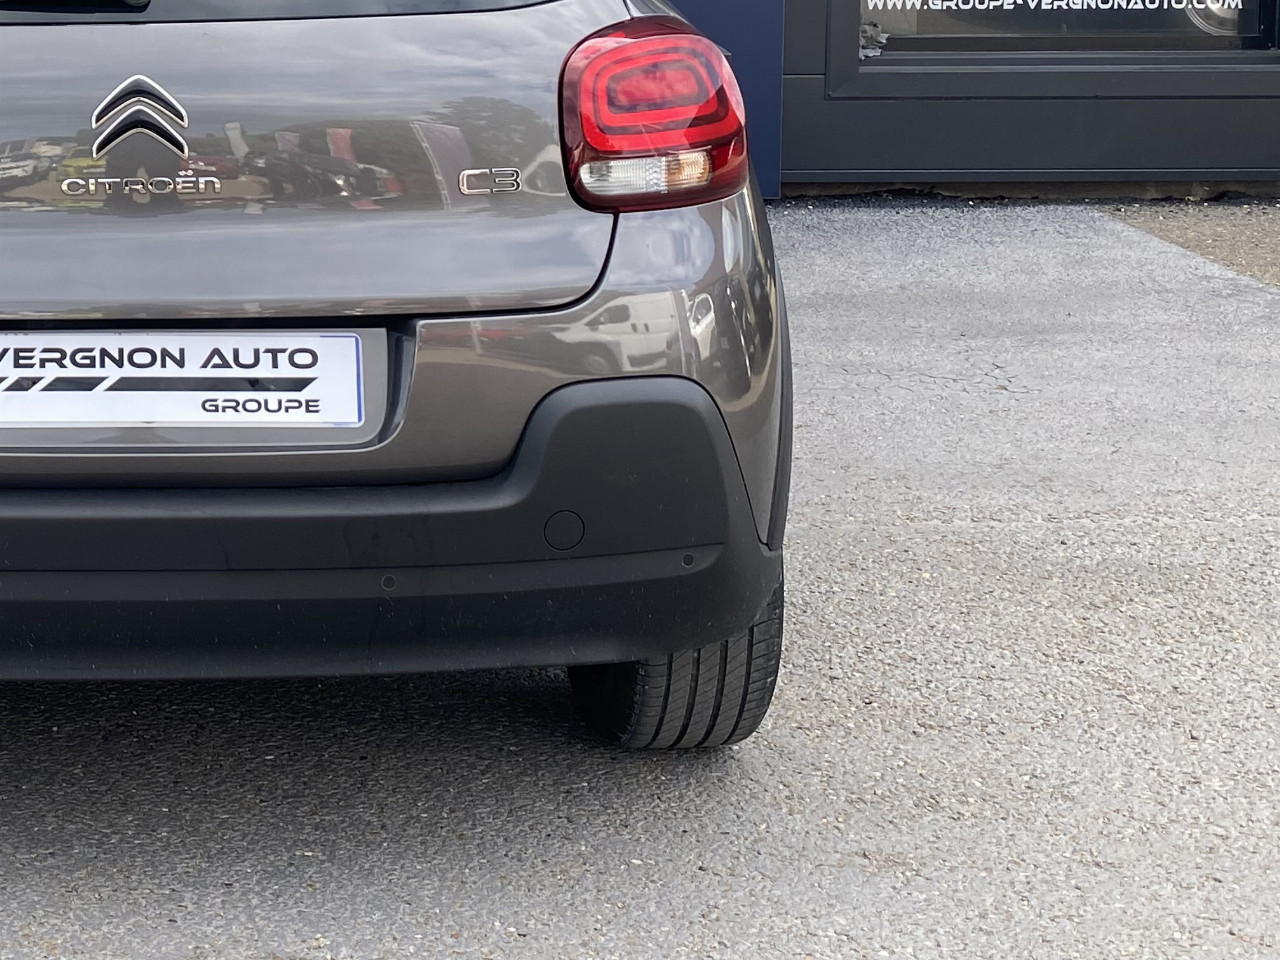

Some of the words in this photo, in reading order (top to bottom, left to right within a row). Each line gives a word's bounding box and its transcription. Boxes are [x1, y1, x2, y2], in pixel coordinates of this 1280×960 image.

[60, 169, 221, 195] CITROËN
[457, 167, 522, 196] C3
[199, 346, 320, 369] AUTO
[201, 397, 321, 414] GROUPE
